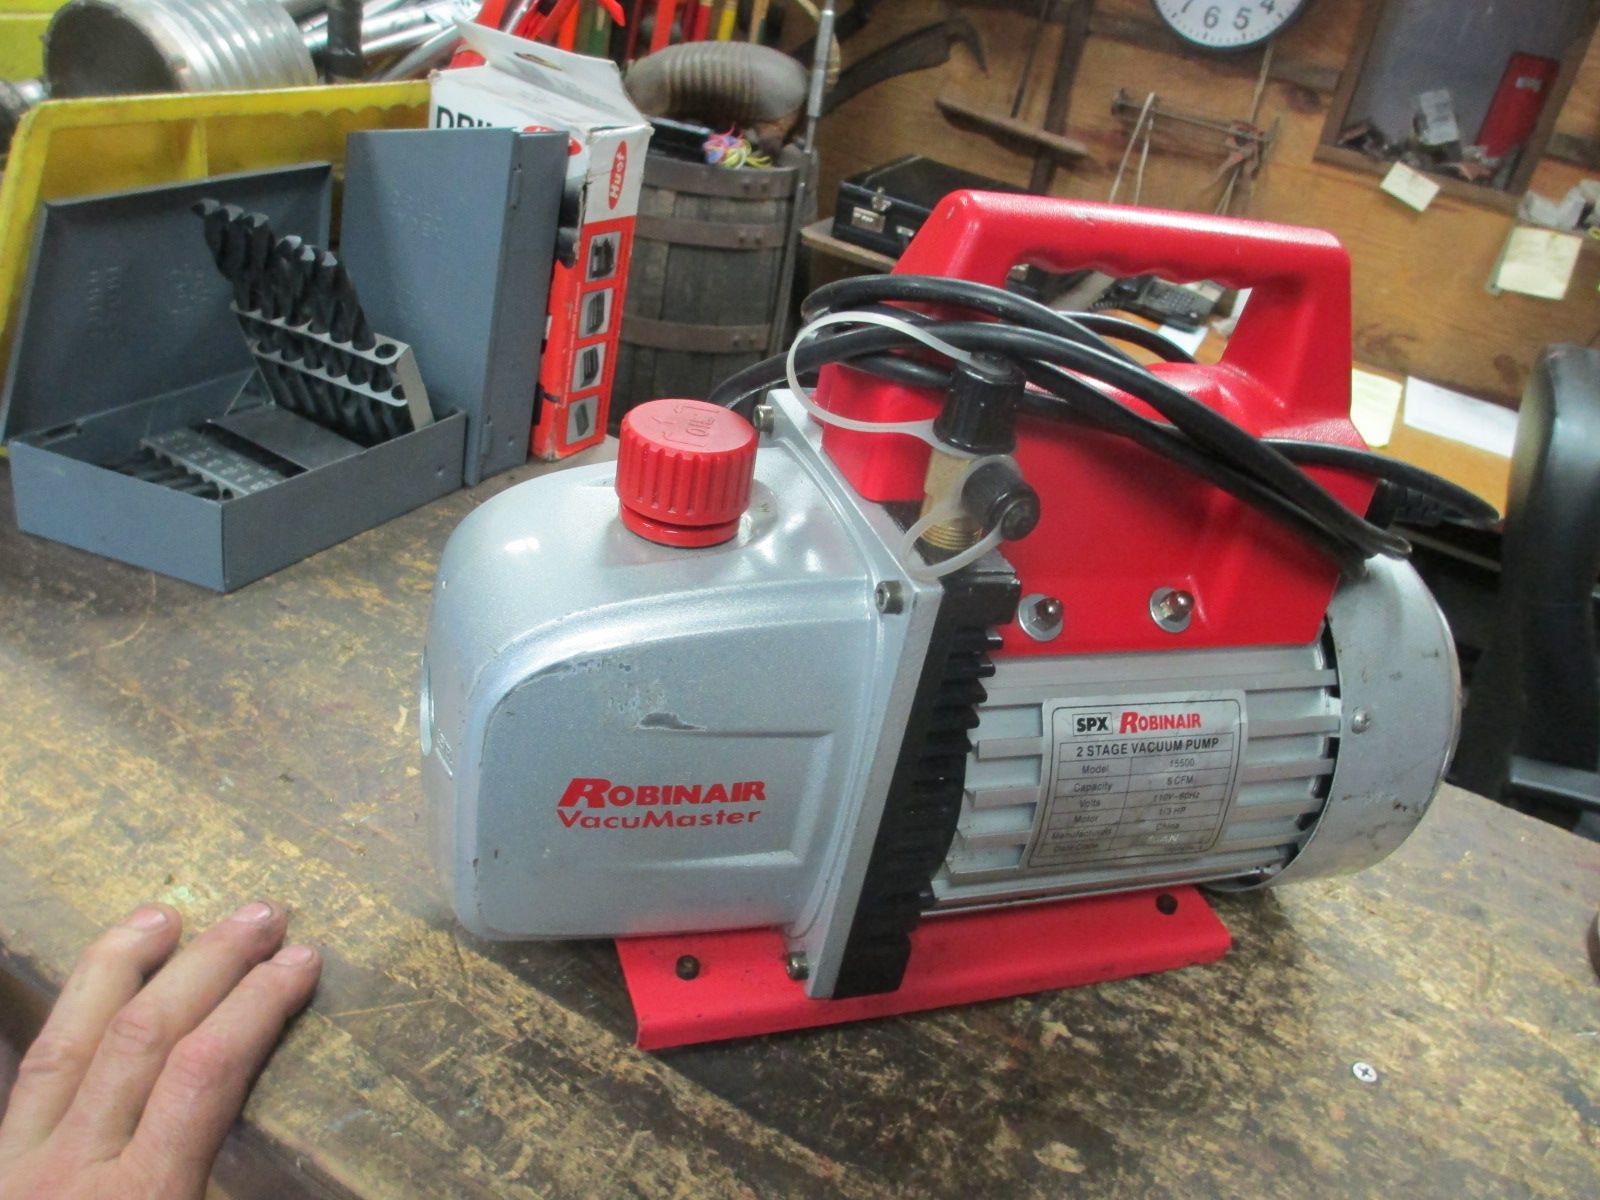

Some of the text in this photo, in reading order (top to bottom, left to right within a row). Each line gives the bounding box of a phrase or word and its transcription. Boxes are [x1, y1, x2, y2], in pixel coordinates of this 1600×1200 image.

[1204, 5, 1221, 29] 6
[1233, 7, 1252, 30] 5
[1076, 711, 1201, 734] SPX ROBINAIR
[1077, 738, 1219, 758] 2 STAGE VACUUM PUMP
[1082, 758, 1195, 775] Model 15500
[558, 778, 766, 808] ROBINAIR
[1074, 783, 1113, 793] Capacity
[1174, 775, 1194, 785] CFM
[556, 809, 761, 829] VacuMaster
